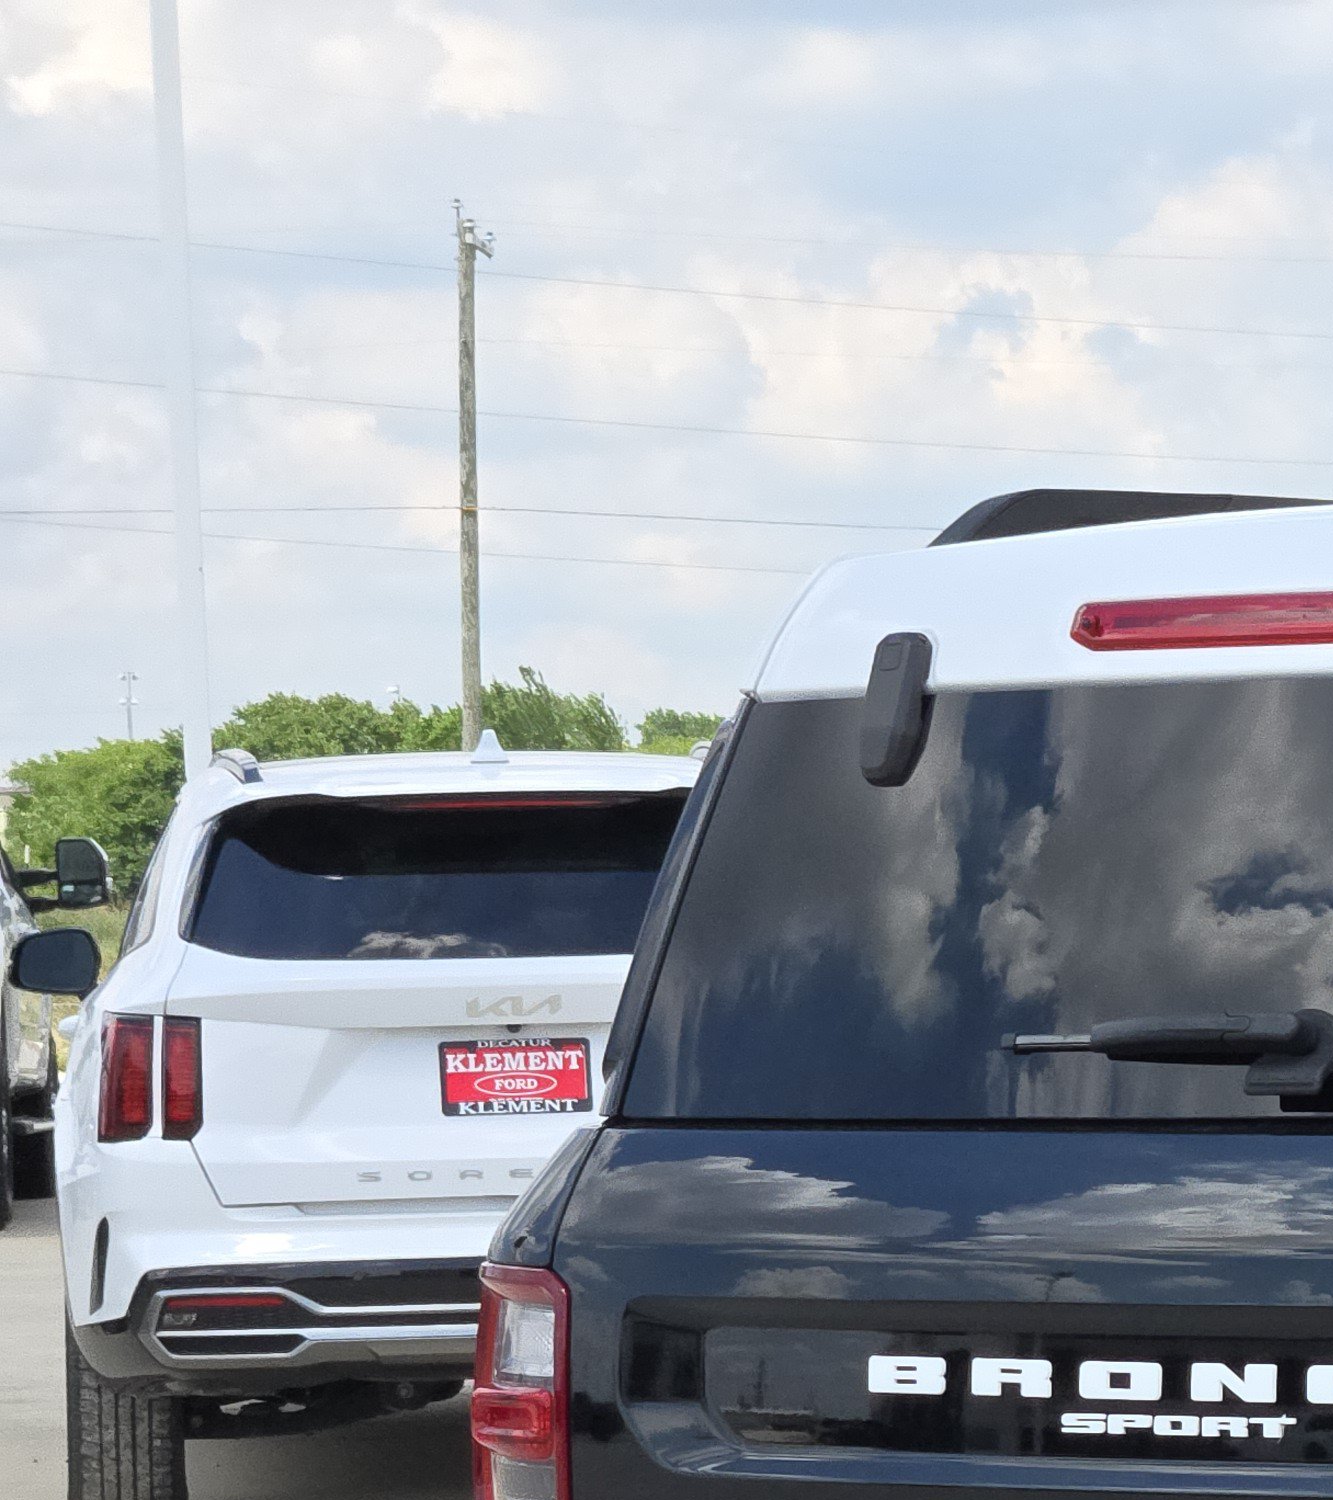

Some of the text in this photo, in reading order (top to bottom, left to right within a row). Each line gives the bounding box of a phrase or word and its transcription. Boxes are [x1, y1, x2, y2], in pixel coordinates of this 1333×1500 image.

[476, 1038, 552, 1048] DECATUR
[445, 1050, 584, 1073] KLEMENT
[494, 1078, 539, 1090] FORD
[458, 1098, 579, 1115] KLEMENT
[1060, 1412, 1298, 1439] SPORT
